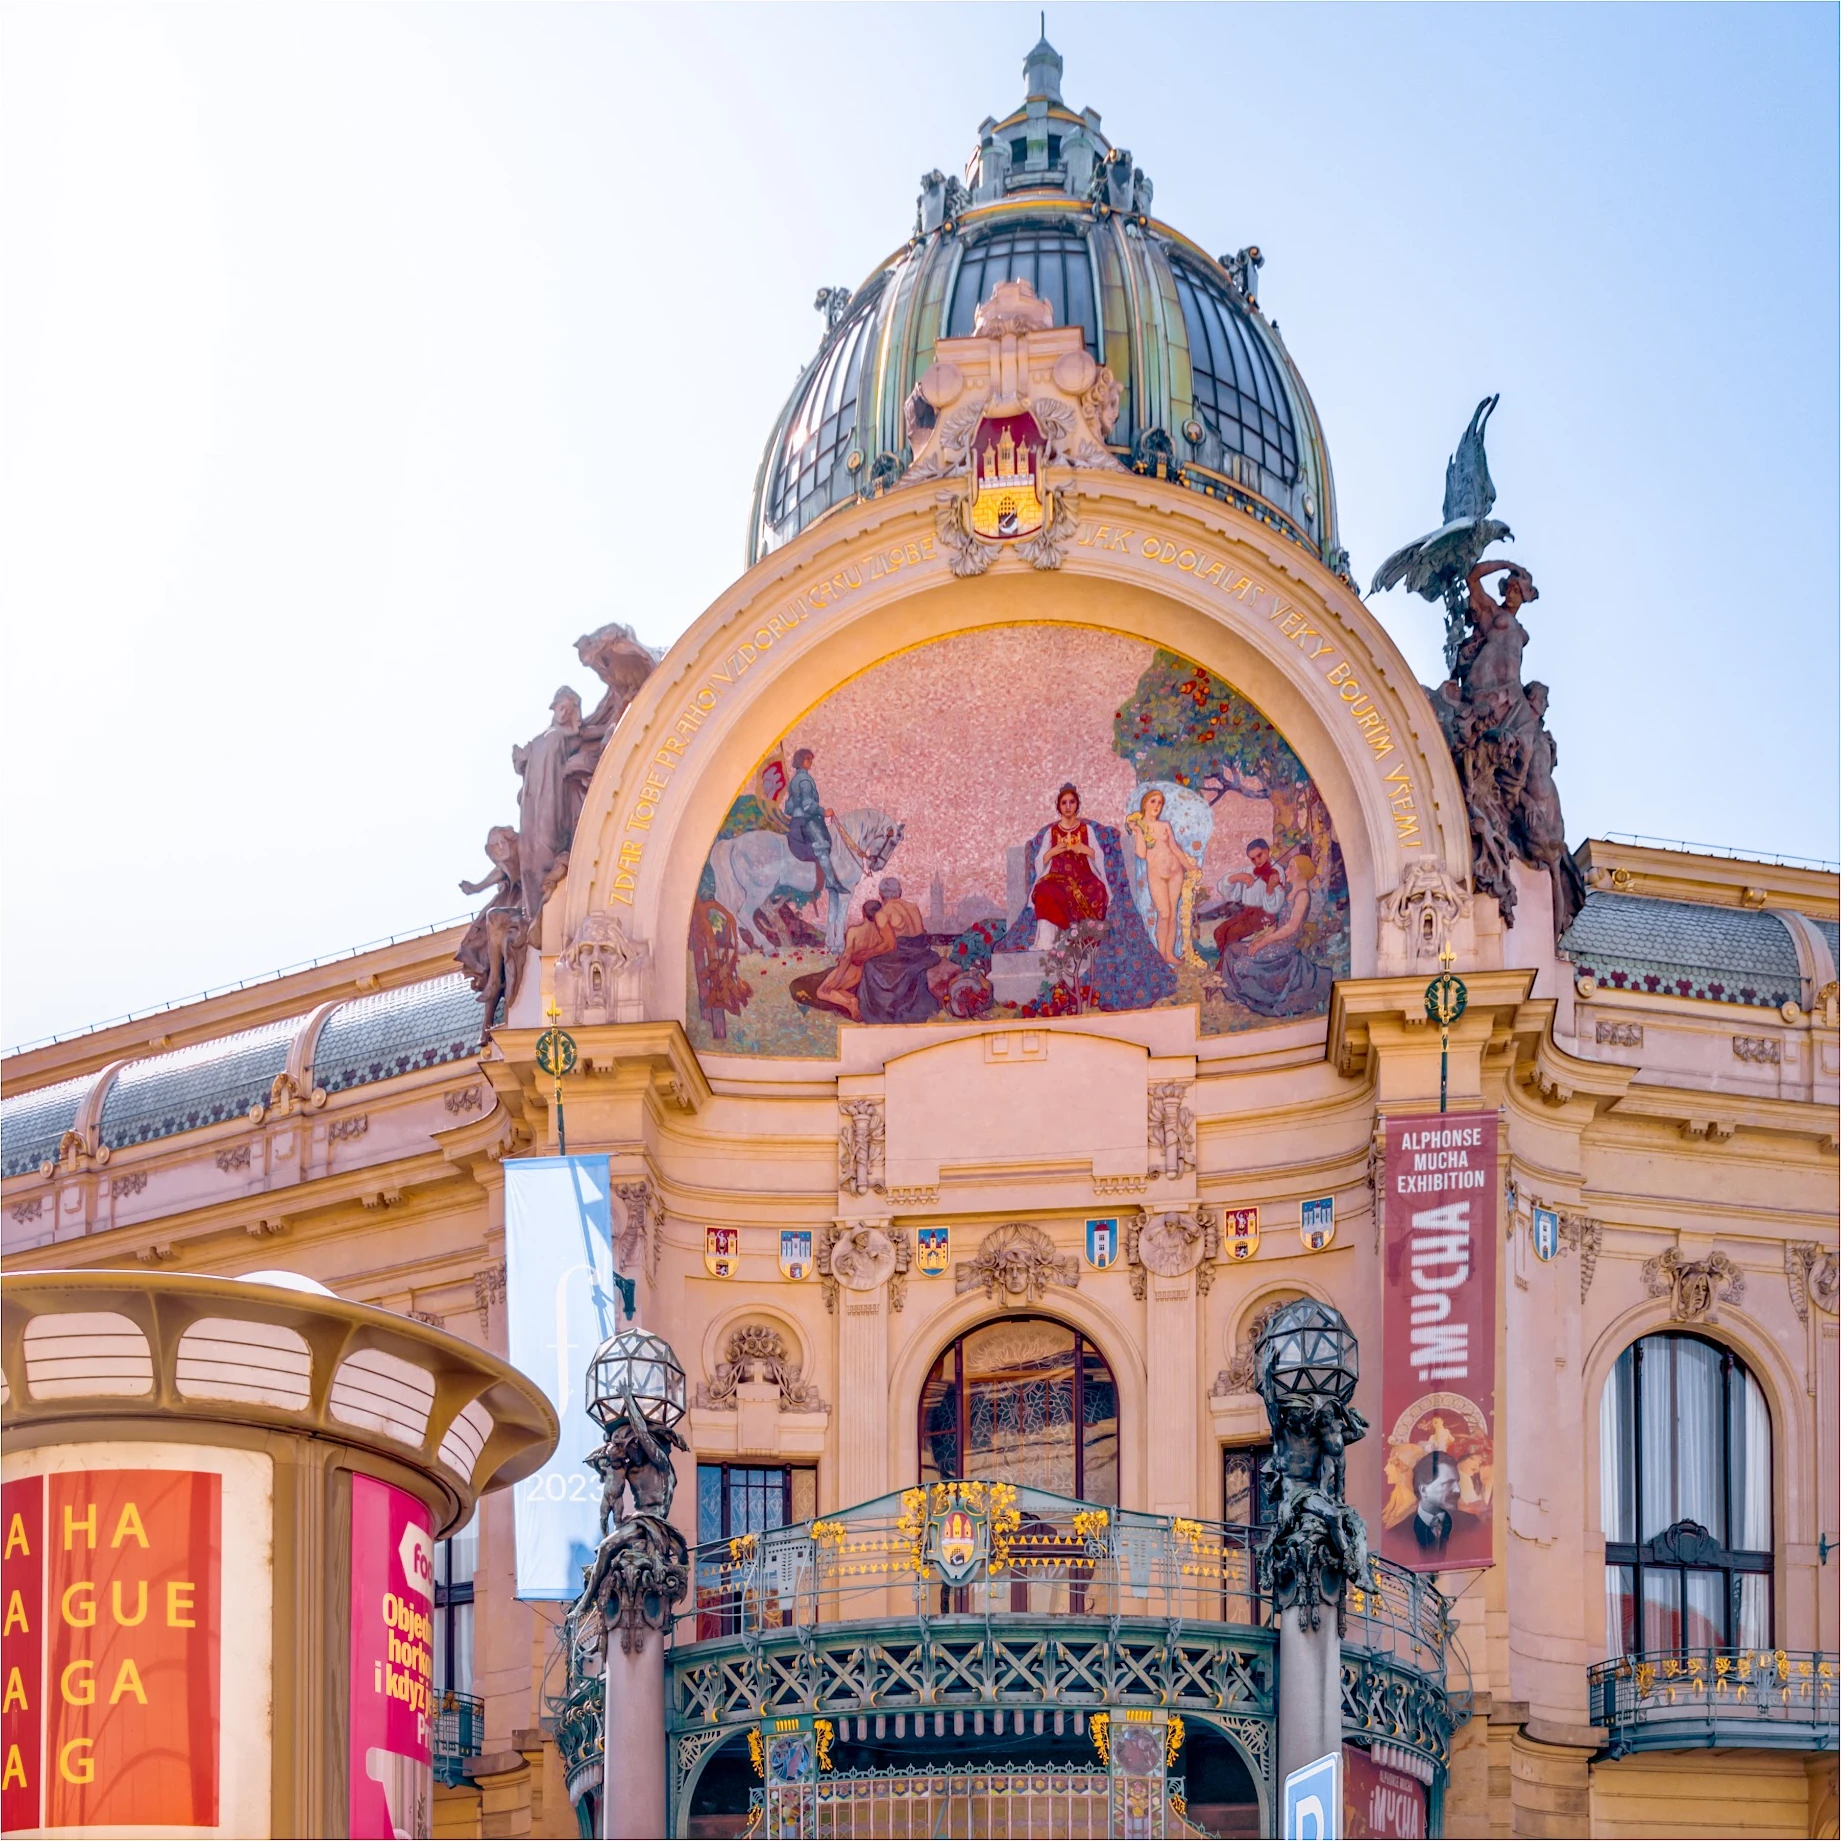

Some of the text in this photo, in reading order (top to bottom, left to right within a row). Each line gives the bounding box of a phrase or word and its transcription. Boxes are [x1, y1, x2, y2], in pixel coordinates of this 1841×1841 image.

[1078, 523, 1135, 553] JAK
[1141, 536, 1265, 607] ODOLALAS
[1268, 598, 1335, 661] VĚKY
[608, 840, 645, 906] ZDAR
[653, 682, 723, 770] PRAHO!
[712, 599, 808, 684] VZDORUJ
[1402, 1128, 1481, 1150] ALPHONSE
[1414, 1150, 1468, 1171] MUCHA
[1398, 1170, 1484, 1193] EXHIBITION
[375, 1660, 381, 1693] i
[386, 1663, 424, 1711] když
